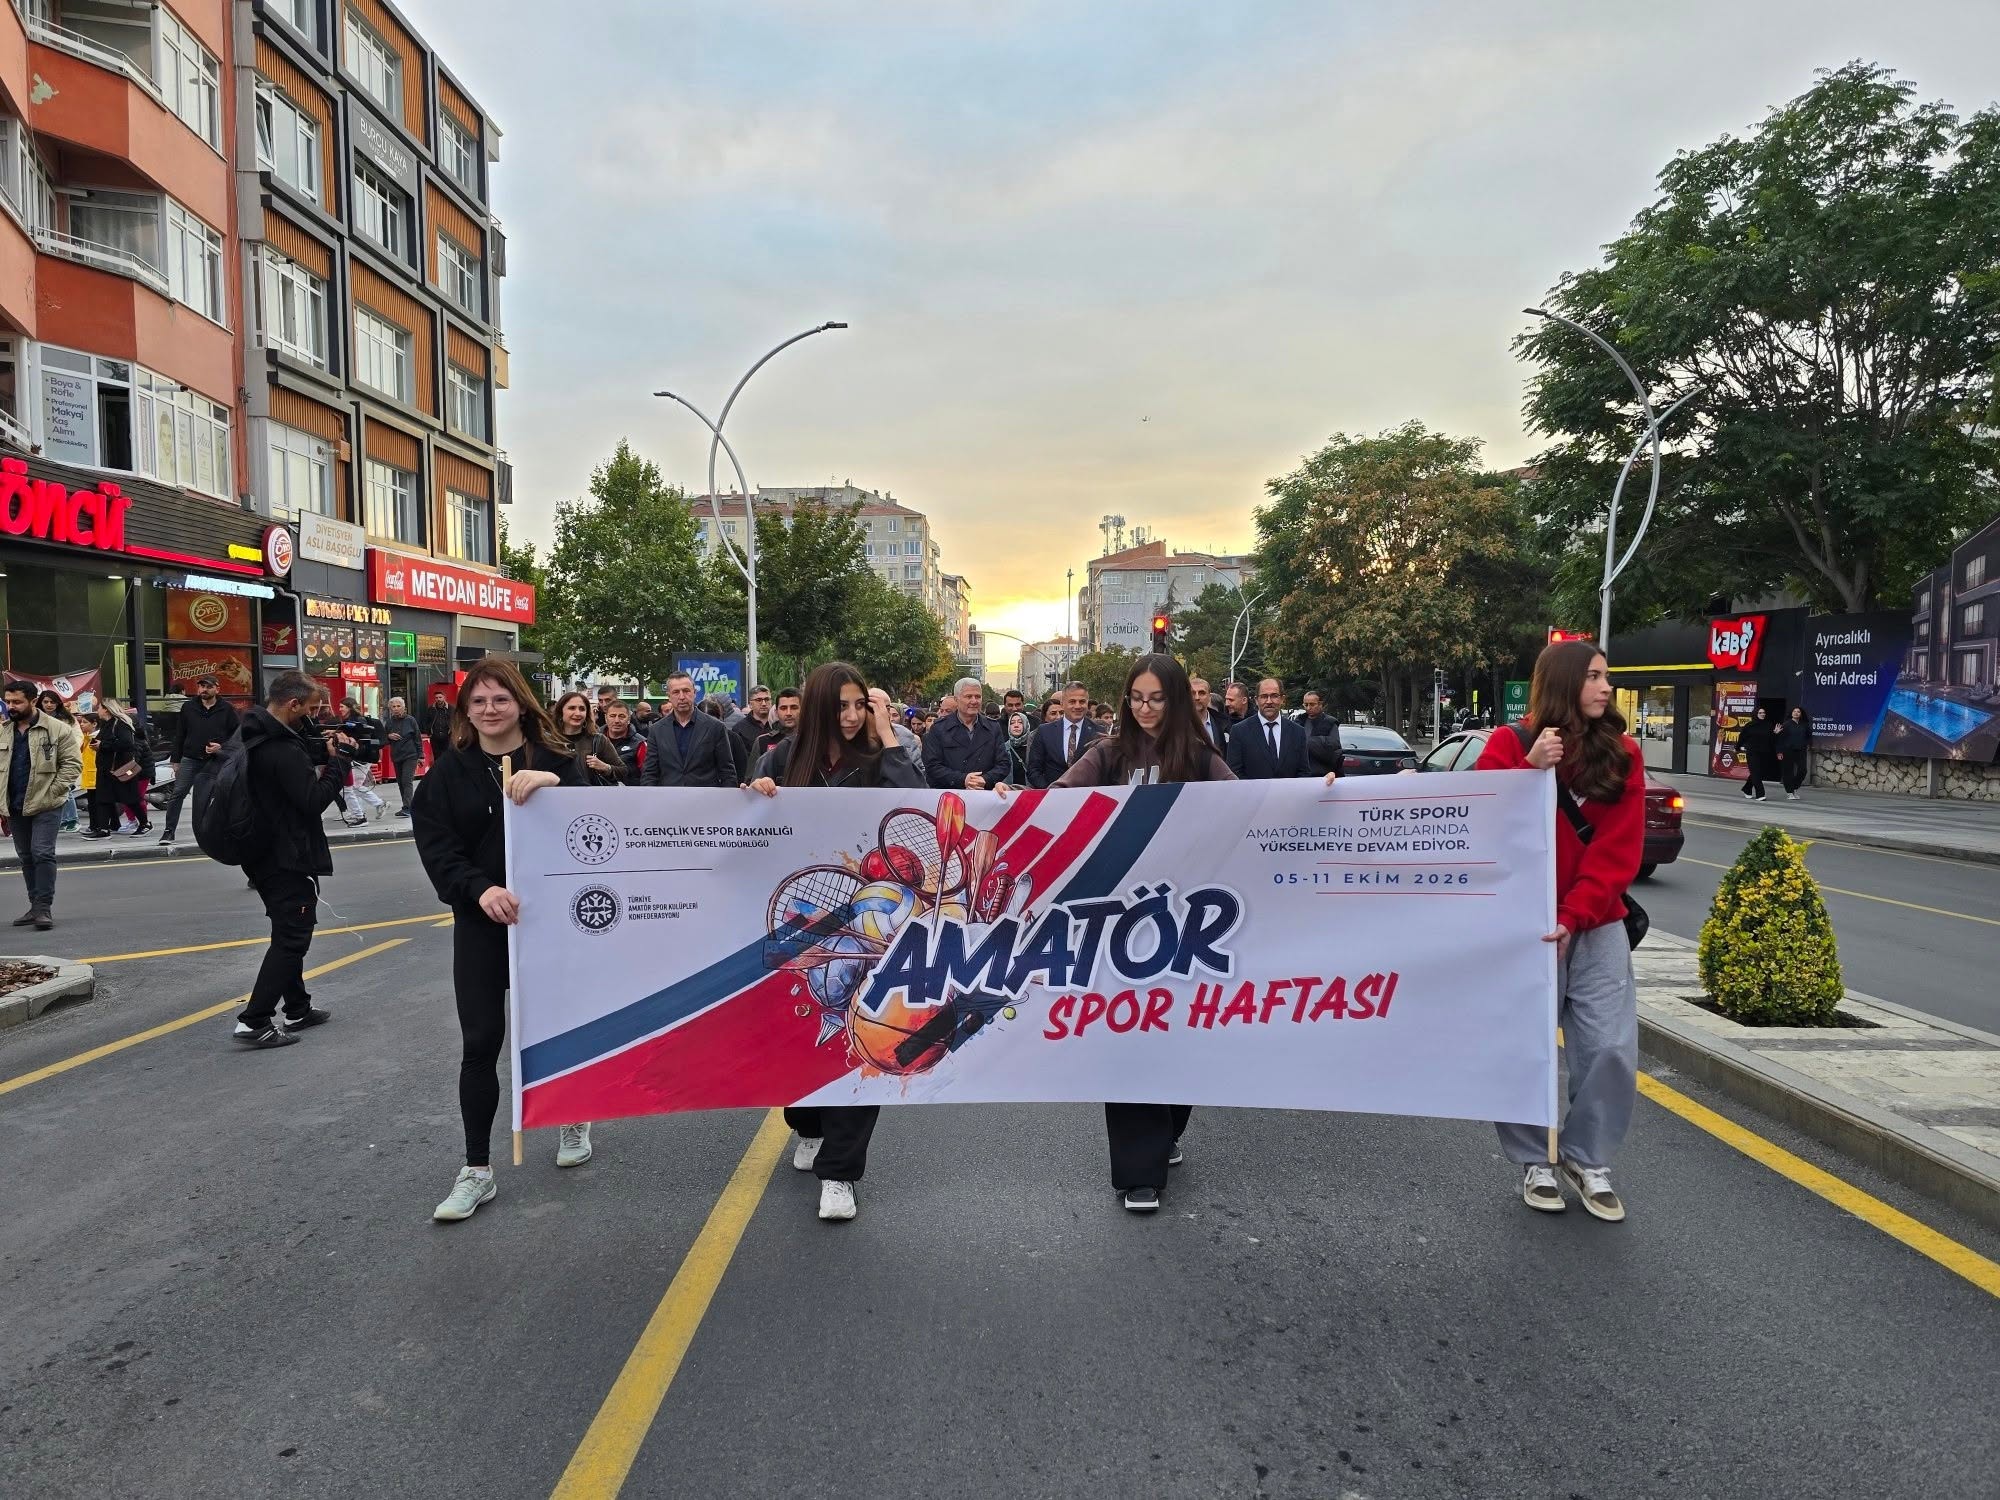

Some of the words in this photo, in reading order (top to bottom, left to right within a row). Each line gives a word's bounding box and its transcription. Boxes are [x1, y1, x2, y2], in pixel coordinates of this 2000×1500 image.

[361, 117, 386, 154] BURCU
[389, 145, 408, 173] KAYA
[50, 377, 73, 389] Boya
[75, 381, 81, 390] &
[50, 387, 75, 398] Röfle
[51, 407, 84, 420] Makyaj
[51, 416, 69, 428] Kaş
[411, 569, 476, 606] MEYDAN
[479, 579, 512, 612] BÜFE
[1106, 622, 1139, 634] KÖMÜR
[1815, 629, 1871, 649] Ayrıcalıklı
[1815, 652, 1861, 666] Yaşamın
[1814, 671, 1837, 686] Yeni
[1840, 670, 1877, 685] Adresi
[704, 680, 737, 694] VAR
[1812, 722, 1816, 730] 0
[1359, 807, 1405, 822] TÜRK
[1409, 806, 1469, 820] SPORU
[624, 827, 643, 837] T.C.
[644, 826, 690, 839] GENÇLİK
[690, 826, 705, 836] VE
[706, 826, 734, 837] SPOR
[736, 825, 793, 837] BAKANLIĞI
[1245, 825, 1353, 840] AMATÖRLERİN
[1357, 823, 1470, 838] OMUZLARINDA
[625, 841, 647, 849] SPOR
[647, 840, 693, 849] HİZMETLERİ
[693, 840, 718, 849] GENEL
[719, 839, 769, 849] MÜDÜRLÜĞÜ
[1260, 840, 1353, 853] YÜKSELMEYE
[1357, 841, 1408, 853] DEVAM
[1412, 838, 1470, 851] EDİYOR.
[1273, 872, 1330, 884] 05-11
[1344, 871, 1400, 884] EKİM
[1414, 873, 1469, 884] 2026
[628, 895, 652, 903] TÜRKİYE
[628, 903, 652, 912] AMATÖR
[668, 902, 698, 911] KULÜPLERİ
[628, 912, 680, 921] KONFEDERASYONU
[860, 884, 1240, 1013] AMATÖR
[1043, 988, 1176, 1041] SPOR
[1189, 972, 1398, 1029] HAFTASI
